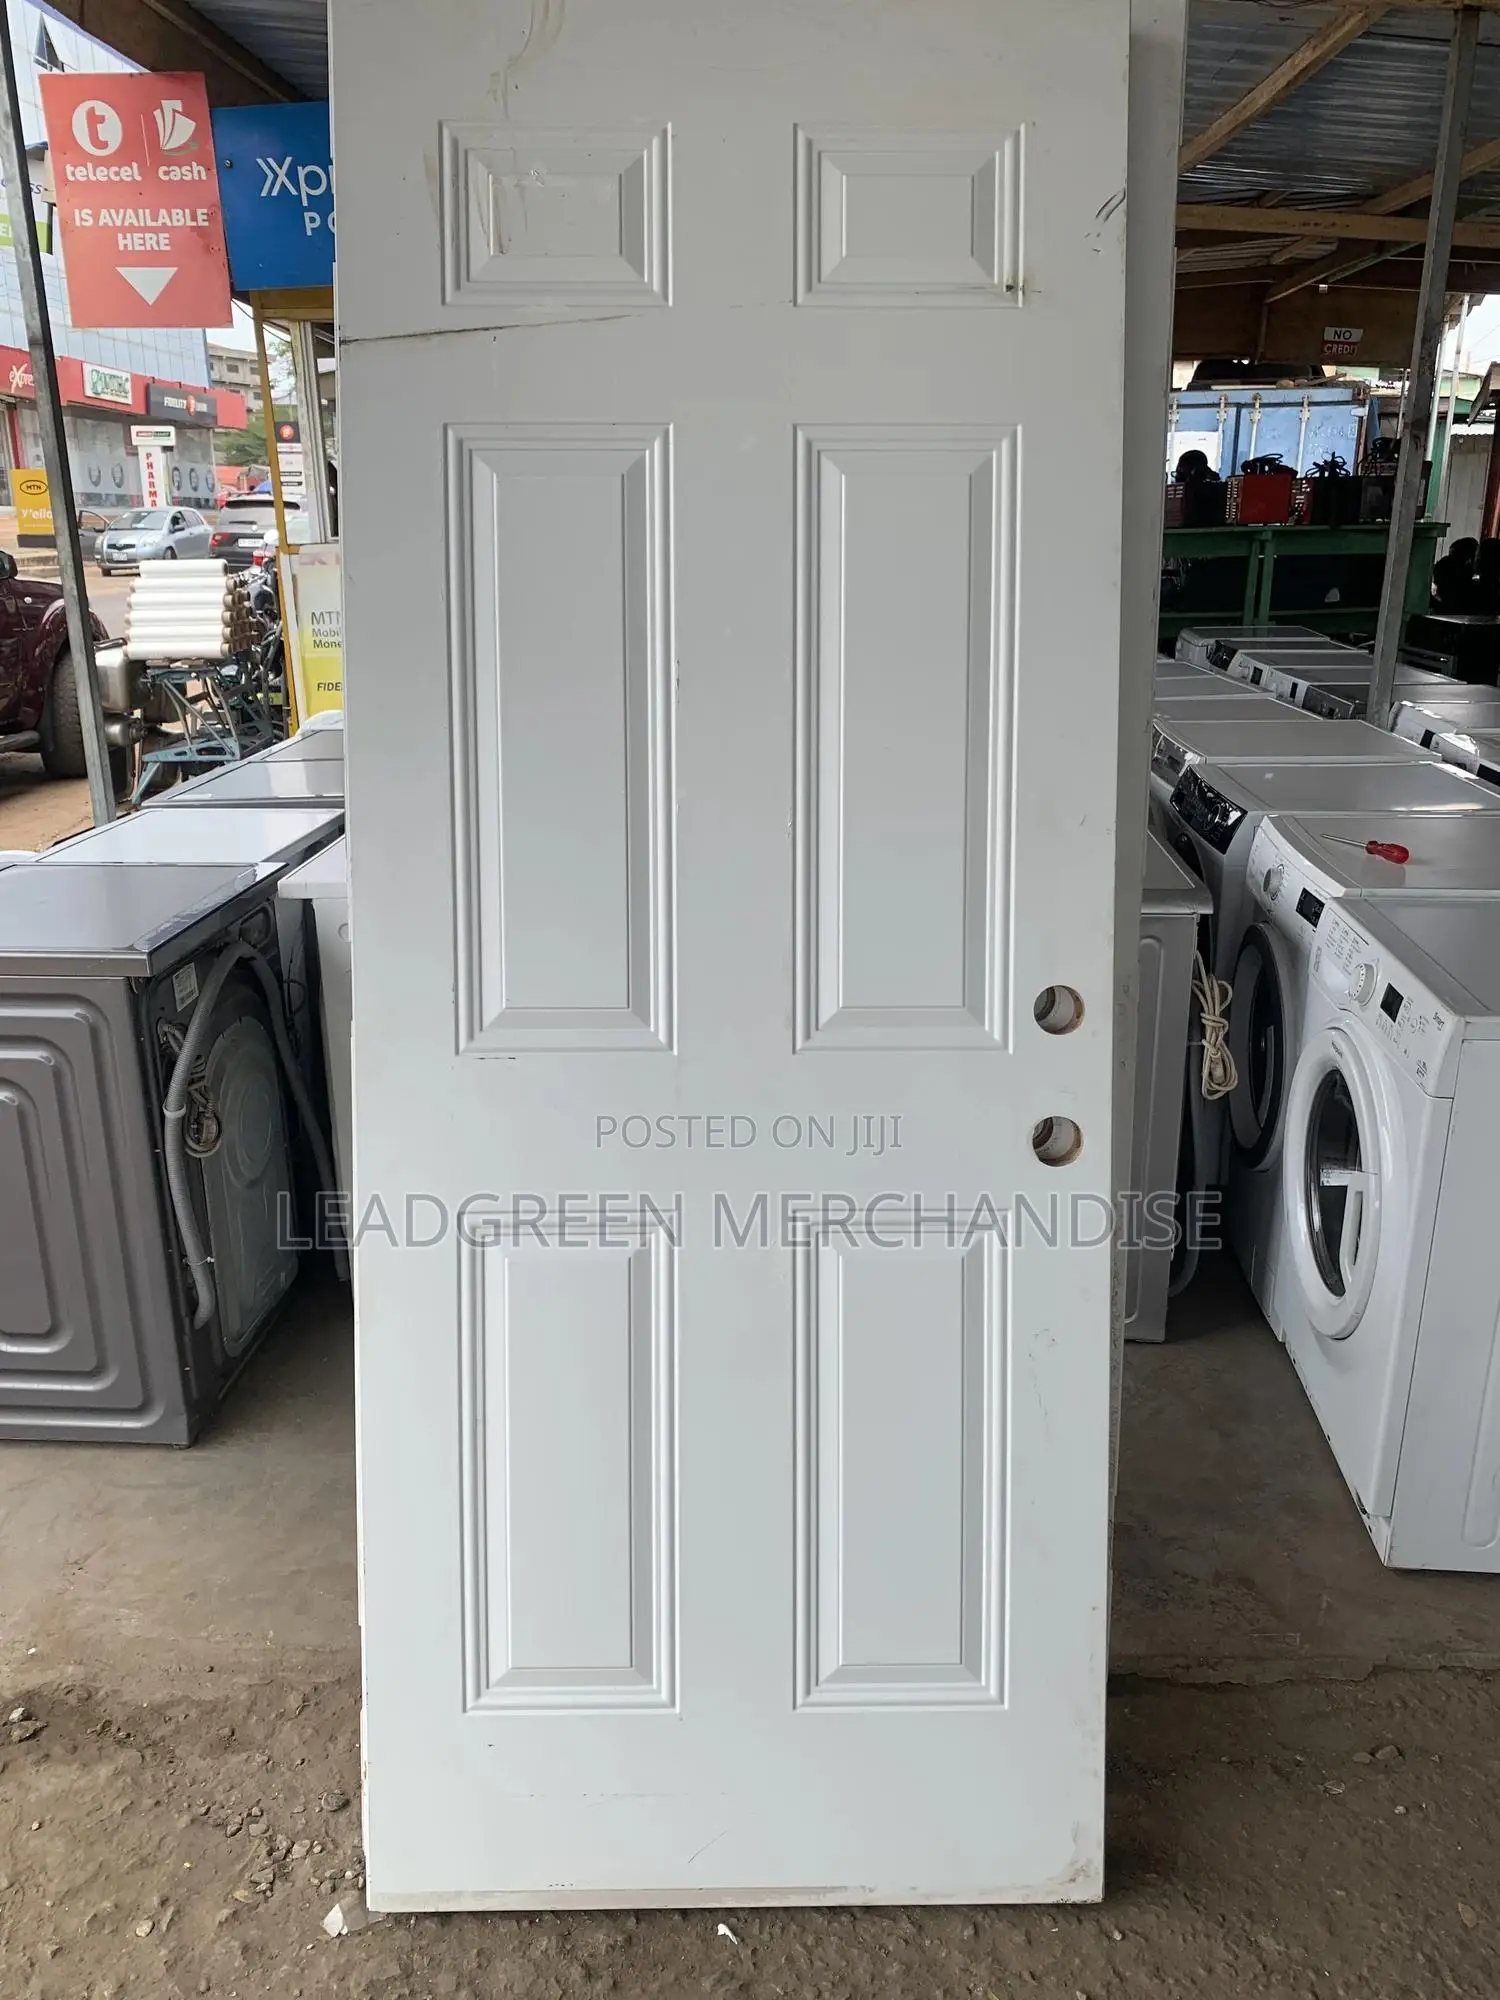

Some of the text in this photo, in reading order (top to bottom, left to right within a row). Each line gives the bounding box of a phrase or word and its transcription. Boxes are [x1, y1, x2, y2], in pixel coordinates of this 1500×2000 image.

[65, 161, 207, 182] telecel cash
[74, 208, 209, 227] IS AVAILABLE
[117, 232, 171, 252] HERE
[1333, 329, 1353, 341] NO
[311, 627, 342, 638] Mobi
[313, 639, 342, 649] Mone
[317, 682, 342, 692] FIDE
